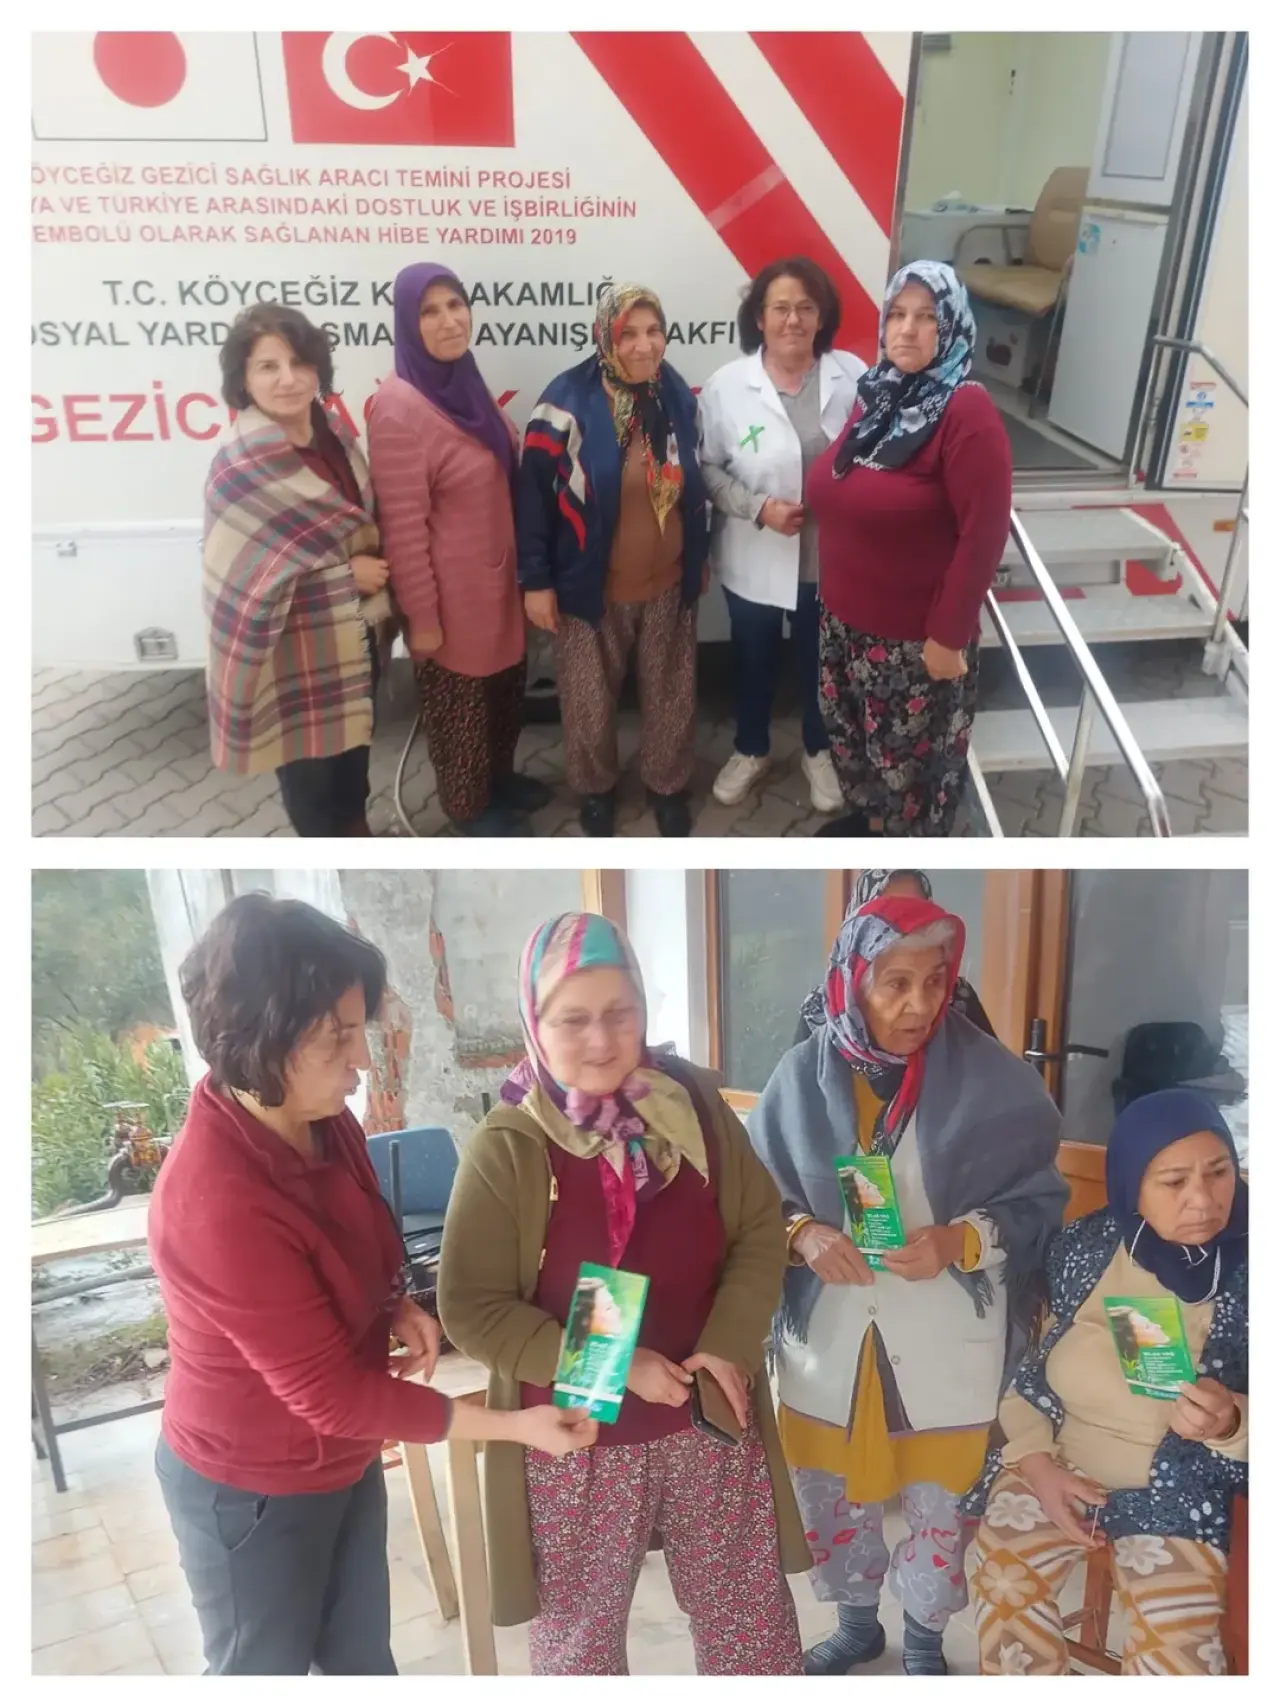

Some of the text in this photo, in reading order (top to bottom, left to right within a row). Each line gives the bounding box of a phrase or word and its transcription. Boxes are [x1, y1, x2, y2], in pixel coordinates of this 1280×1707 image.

[141, 162, 218, 185] GEZİCİ
[225, 163, 311, 186] SAĞLIK
[319, 168, 389, 187] ARACI
[396, 165, 470, 188] TEMİNİ
[478, 167, 570, 190] PROJESİ
[60, 196, 91, 214] VE
[97, 191, 199, 214] TÜRKİYE
[206, 192, 348, 215] ARASINDAKİ
[355, 198, 461, 217] DOSTLUK
[469, 199, 497, 217] VE
[503, 195, 637, 222] İŞBİRLİĞİNİN
[139, 225, 237, 243] OLARAK
[244, 222, 370, 244] SAĞLANAN
[378, 222, 430, 244] HİBE
[436, 227, 524, 245] YARDIMI
[531, 228, 577, 245] 2019
[102, 280, 167, 306] T.C.
[666, 321, 735, 345] AKFI
[31, 380, 238, 443] GEZİC
